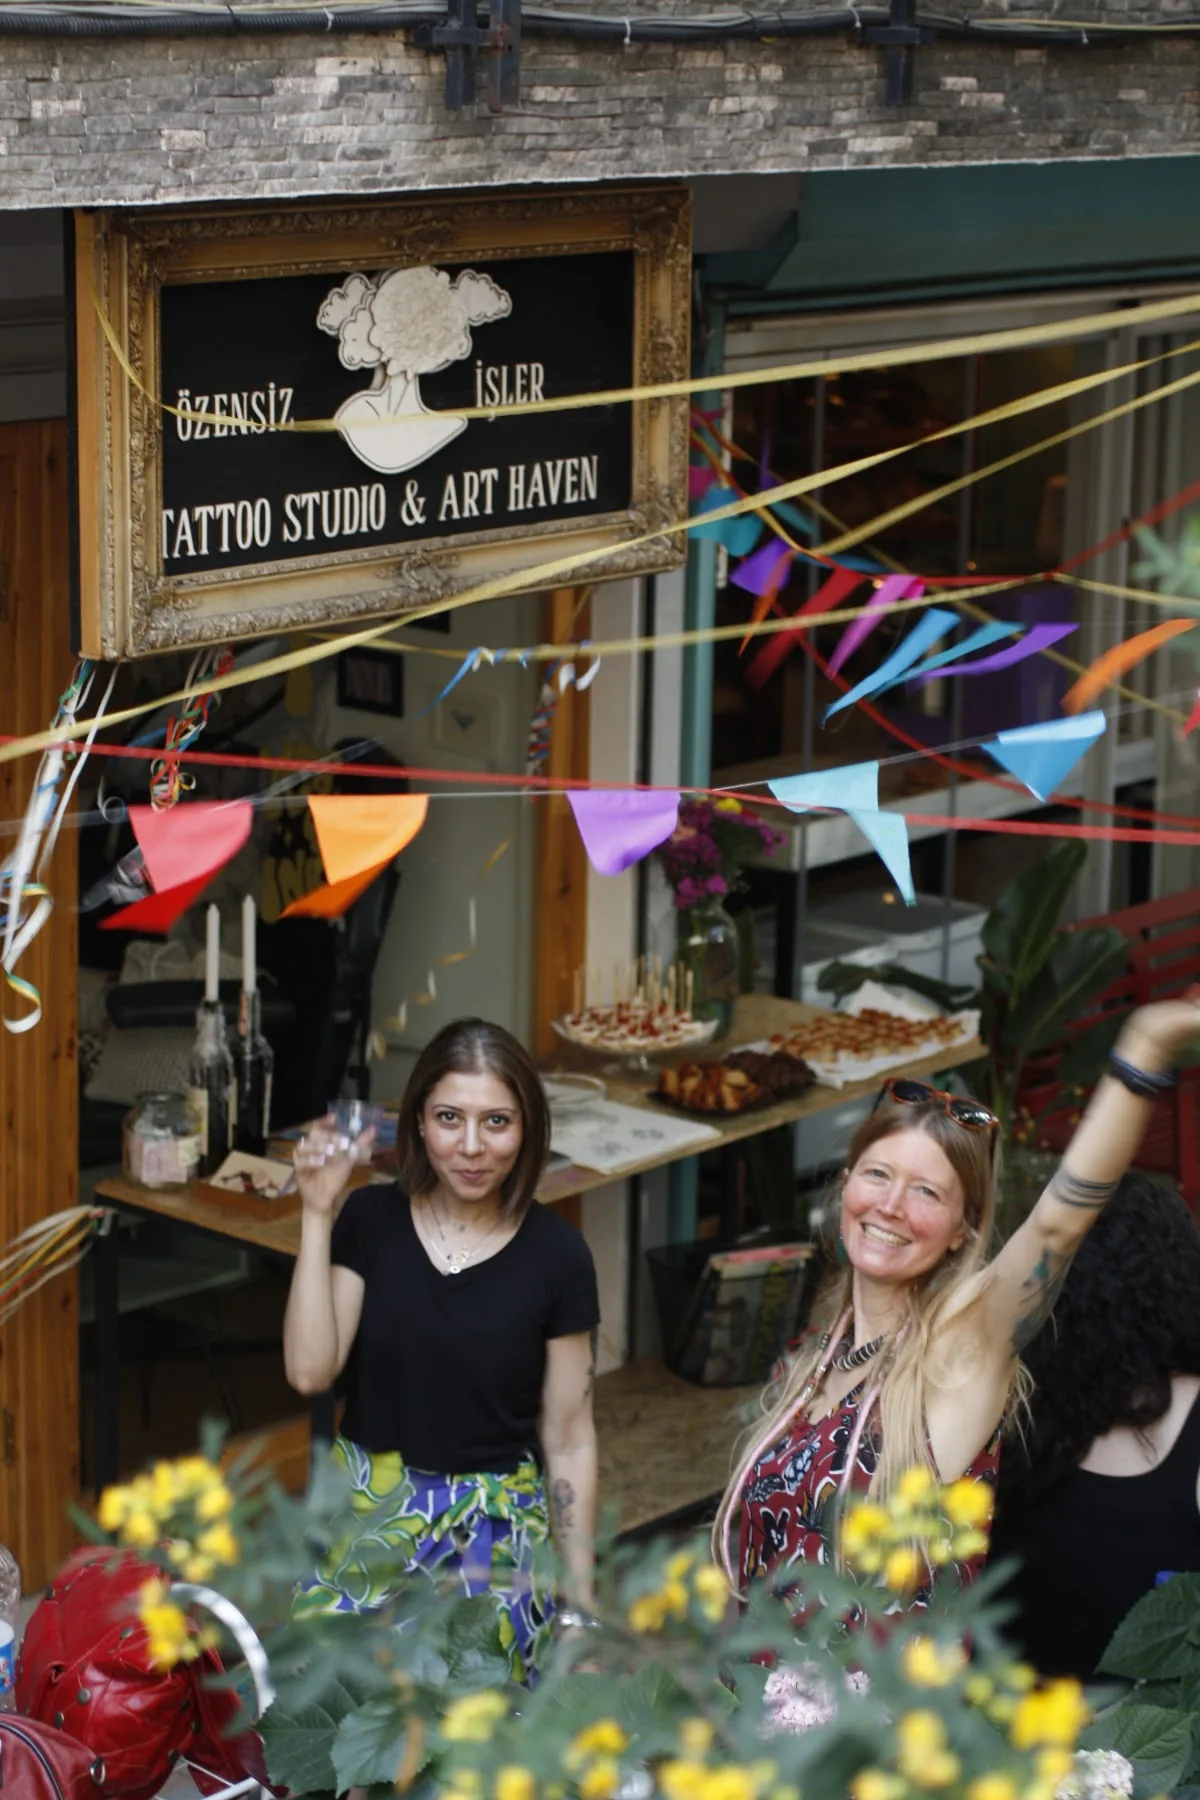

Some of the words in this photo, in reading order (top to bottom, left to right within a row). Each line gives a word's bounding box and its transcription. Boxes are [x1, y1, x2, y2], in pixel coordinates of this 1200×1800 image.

[176, 382, 294, 441] ÖZENSİZ
[475, 360, 545, 422] İŞLER
[162, 498, 271, 560] TATTOO
[283, 483, 386, 542] STUDIO
[401, 480, 426, 526] &
[438, 468, 498, 521] ART
[507, 455, 598, 511] HAVEN
